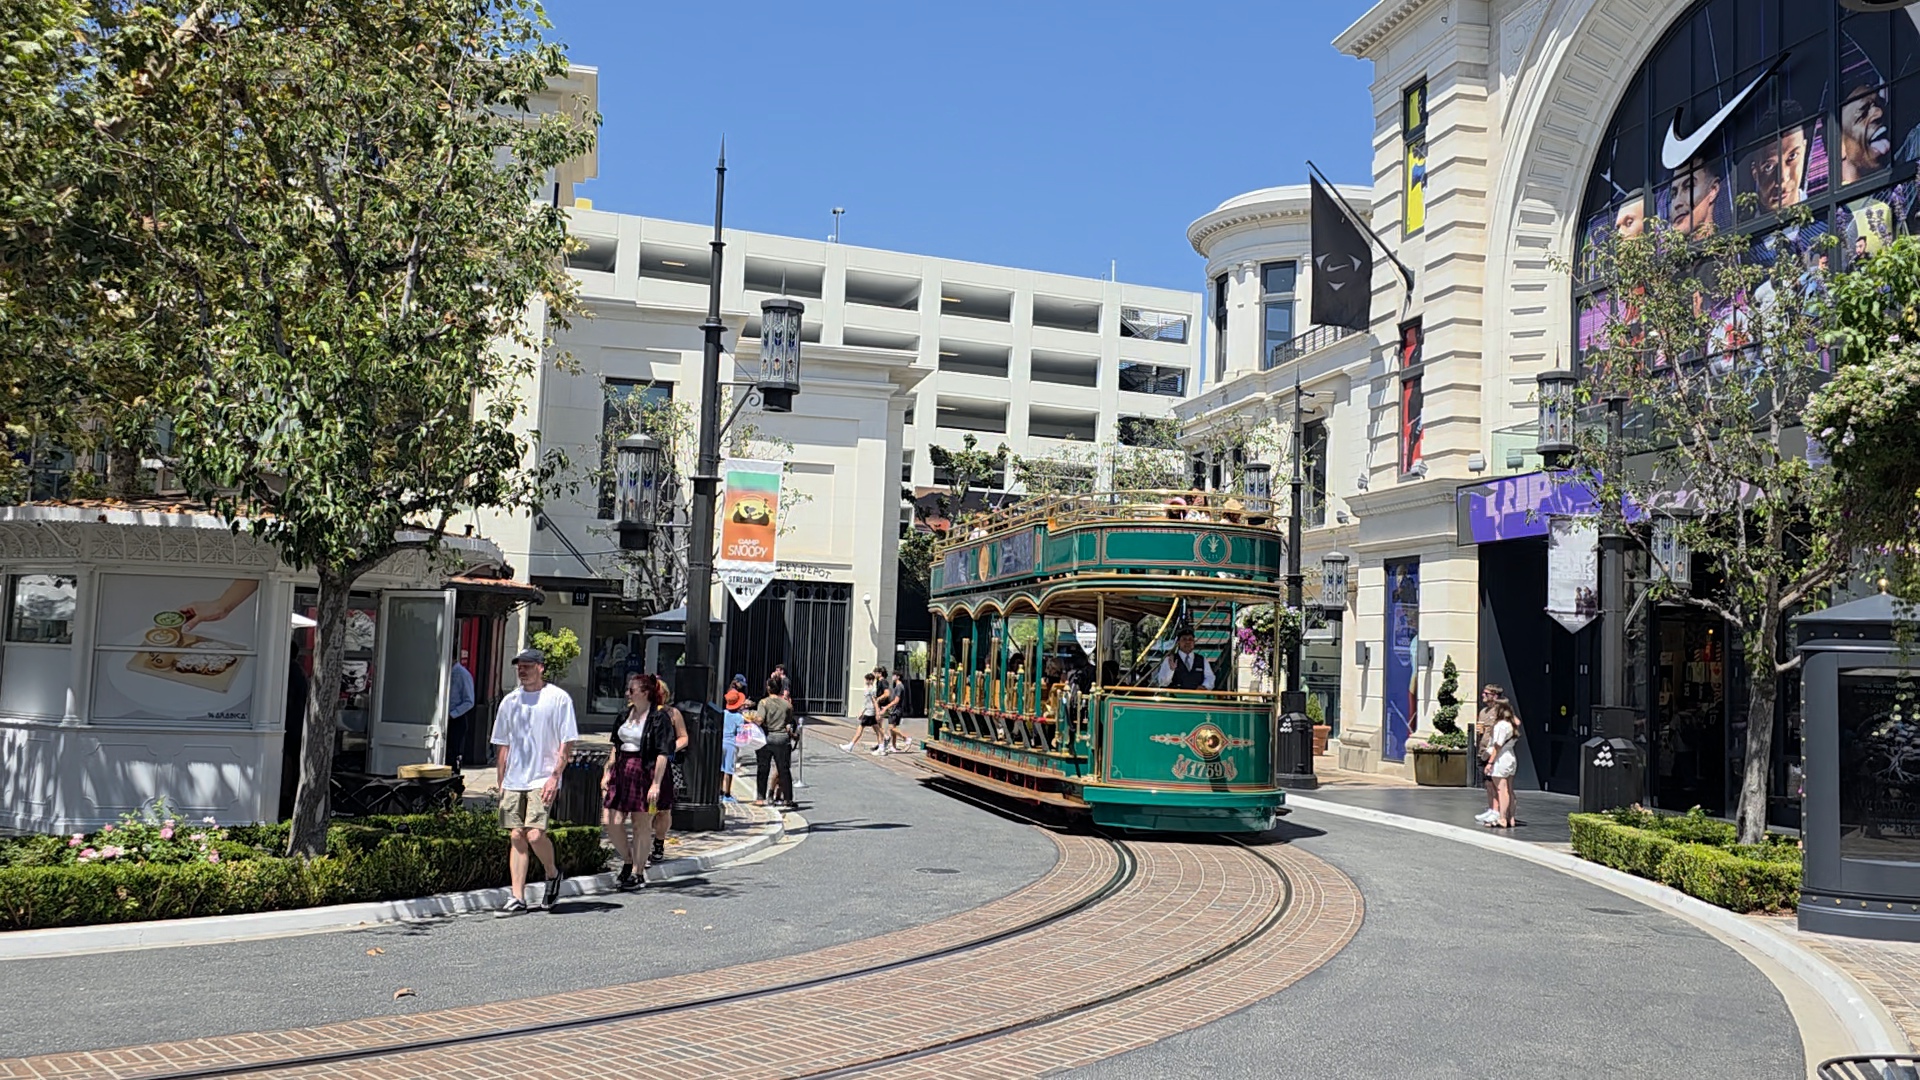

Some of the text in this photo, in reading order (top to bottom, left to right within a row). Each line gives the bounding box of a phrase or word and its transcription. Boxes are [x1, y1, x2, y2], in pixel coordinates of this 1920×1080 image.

[728, 545, 767, 557] SNOOPY
[800, 563, 832, 579] DEPOT
[728, 576, 754, 584] STREAM
[744, 586, 755, 596] tv
